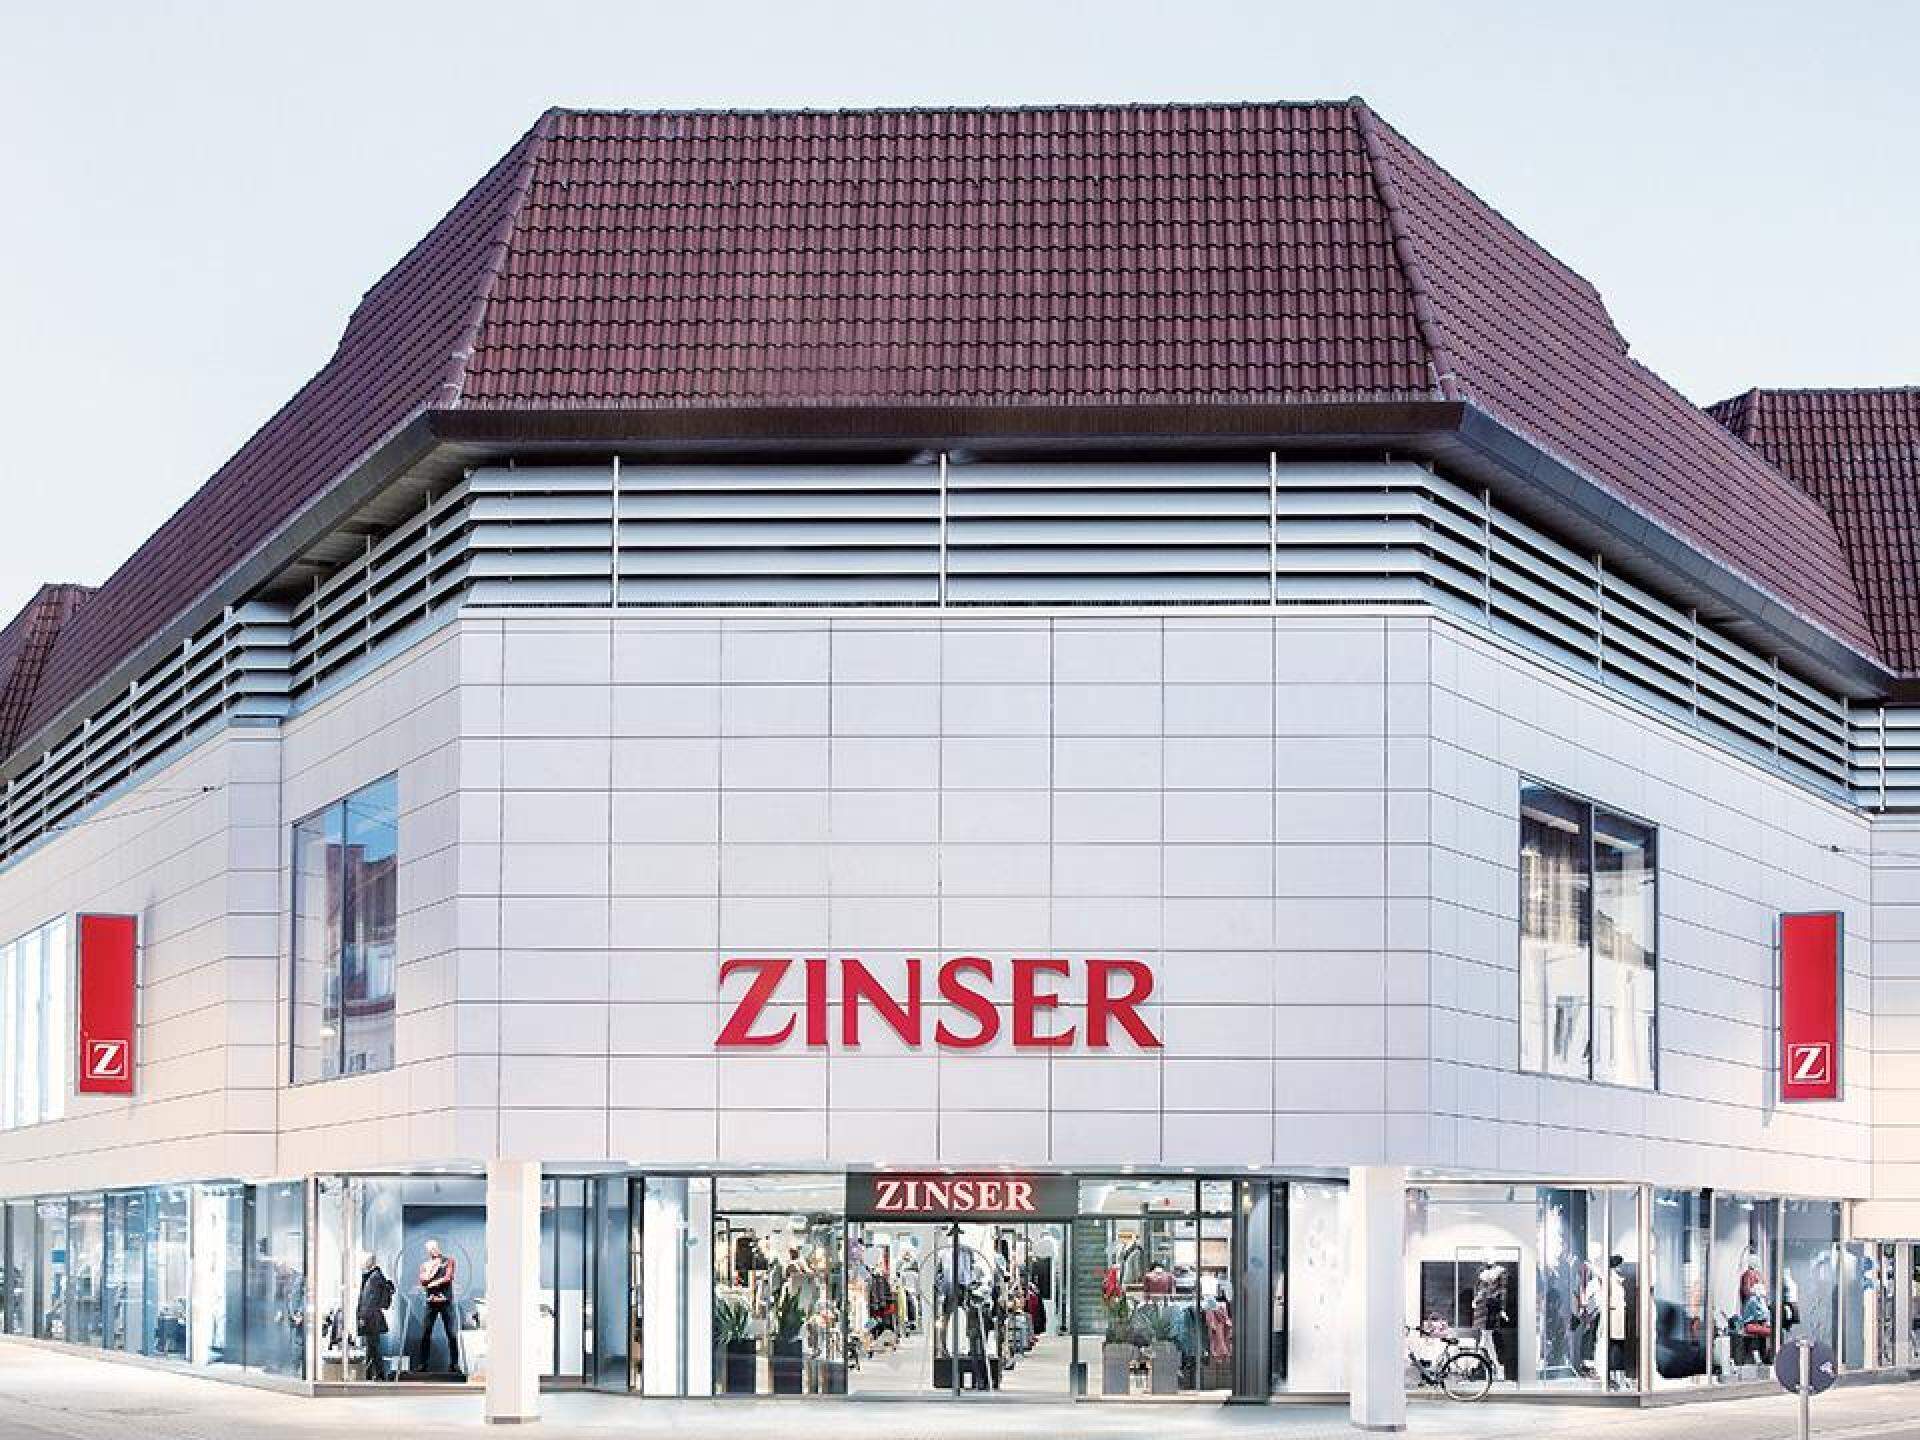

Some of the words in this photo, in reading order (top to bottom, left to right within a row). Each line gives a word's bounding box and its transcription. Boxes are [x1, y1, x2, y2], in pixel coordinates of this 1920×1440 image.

[715, 957, 1163, 1048] ZINSER
[93, 1043, 122, 1074] Z
[1794, 1047, 1824, 1079] Z
[875, 1181, 1035, 1211] ZINSER
